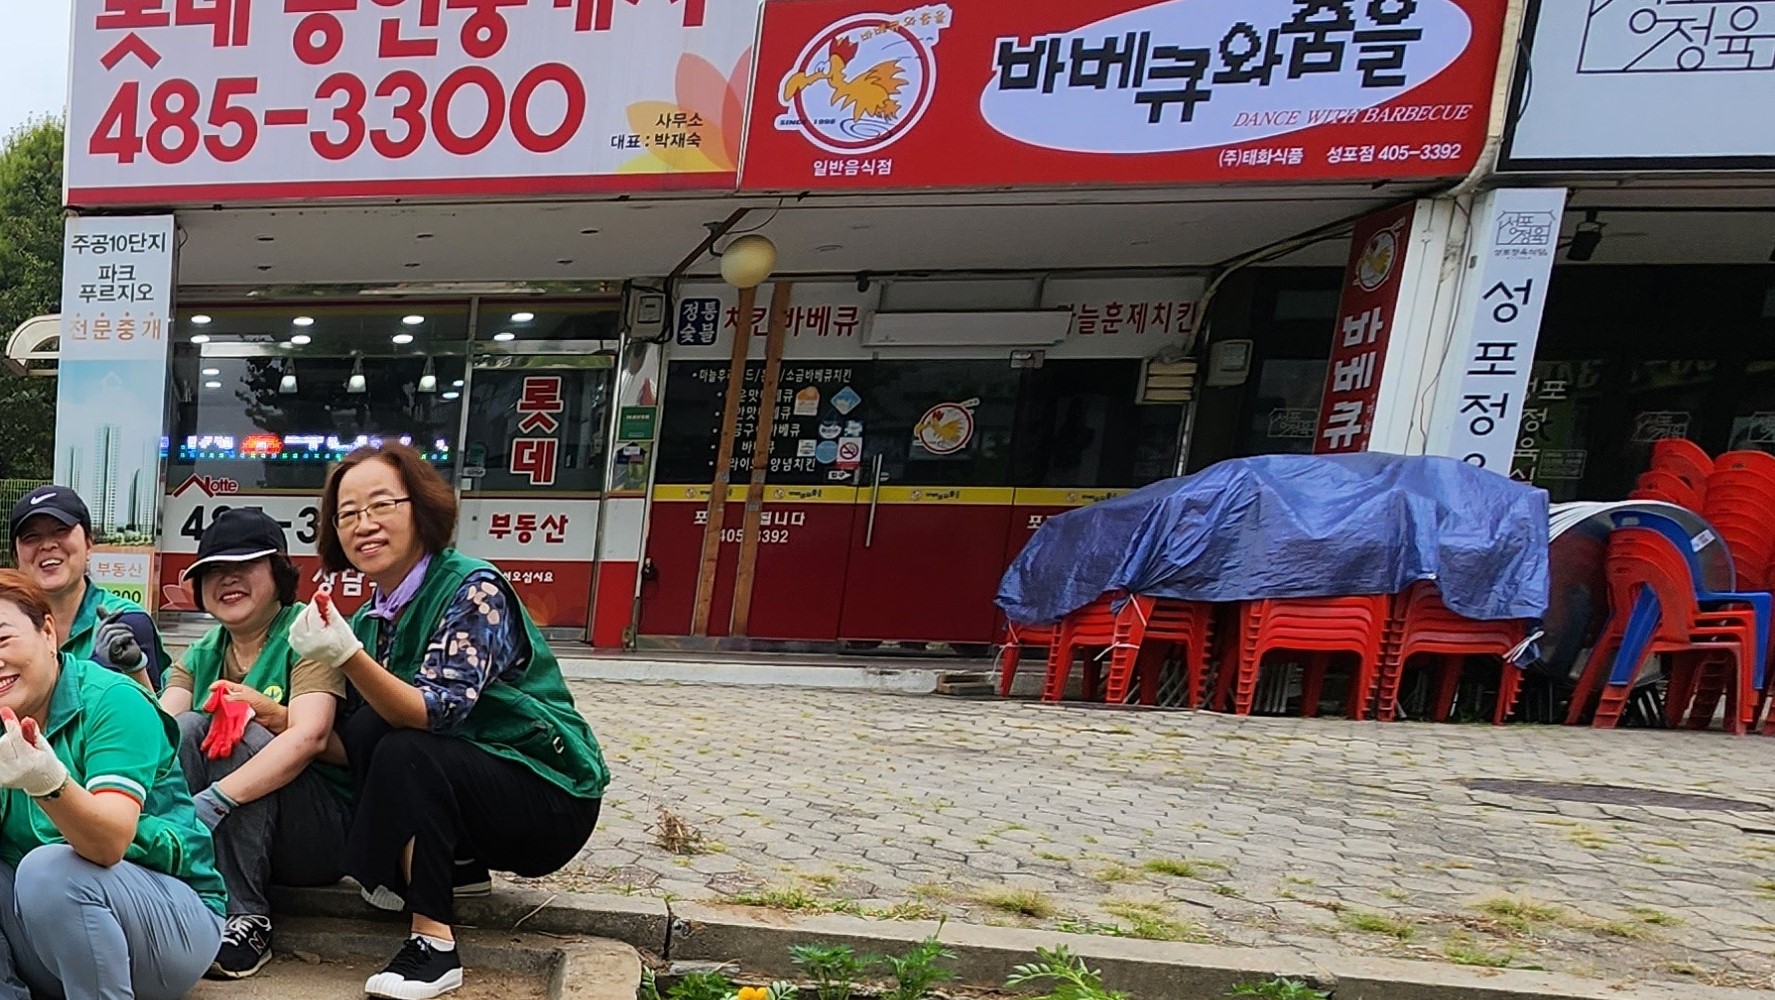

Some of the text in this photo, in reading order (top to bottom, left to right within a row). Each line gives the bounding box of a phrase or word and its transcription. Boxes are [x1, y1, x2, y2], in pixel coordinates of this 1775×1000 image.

[88, 62, 586, 164] 485-3300
[655, 113, 704, 129] 사무소
[1233, 104, 1473, 128] DANCE WITH BARBECUE
[654, 133, 702, 149] 박재숙
[1327, 145, 1375, 164] 성포점
[1378, 143, 1462, 162] 405-3392
[813, 159, 893, 177] 일반음식점
[71, 232, 166, 255] 주공10단지
[98, 263, 136, 284] 파크
[79, 282, 155, 304] 푸르지오
[511, 376, 563, 484] 롯데
[488, 514, 569, 543] 부동산
[97, 562, 143, 577] 부동산
